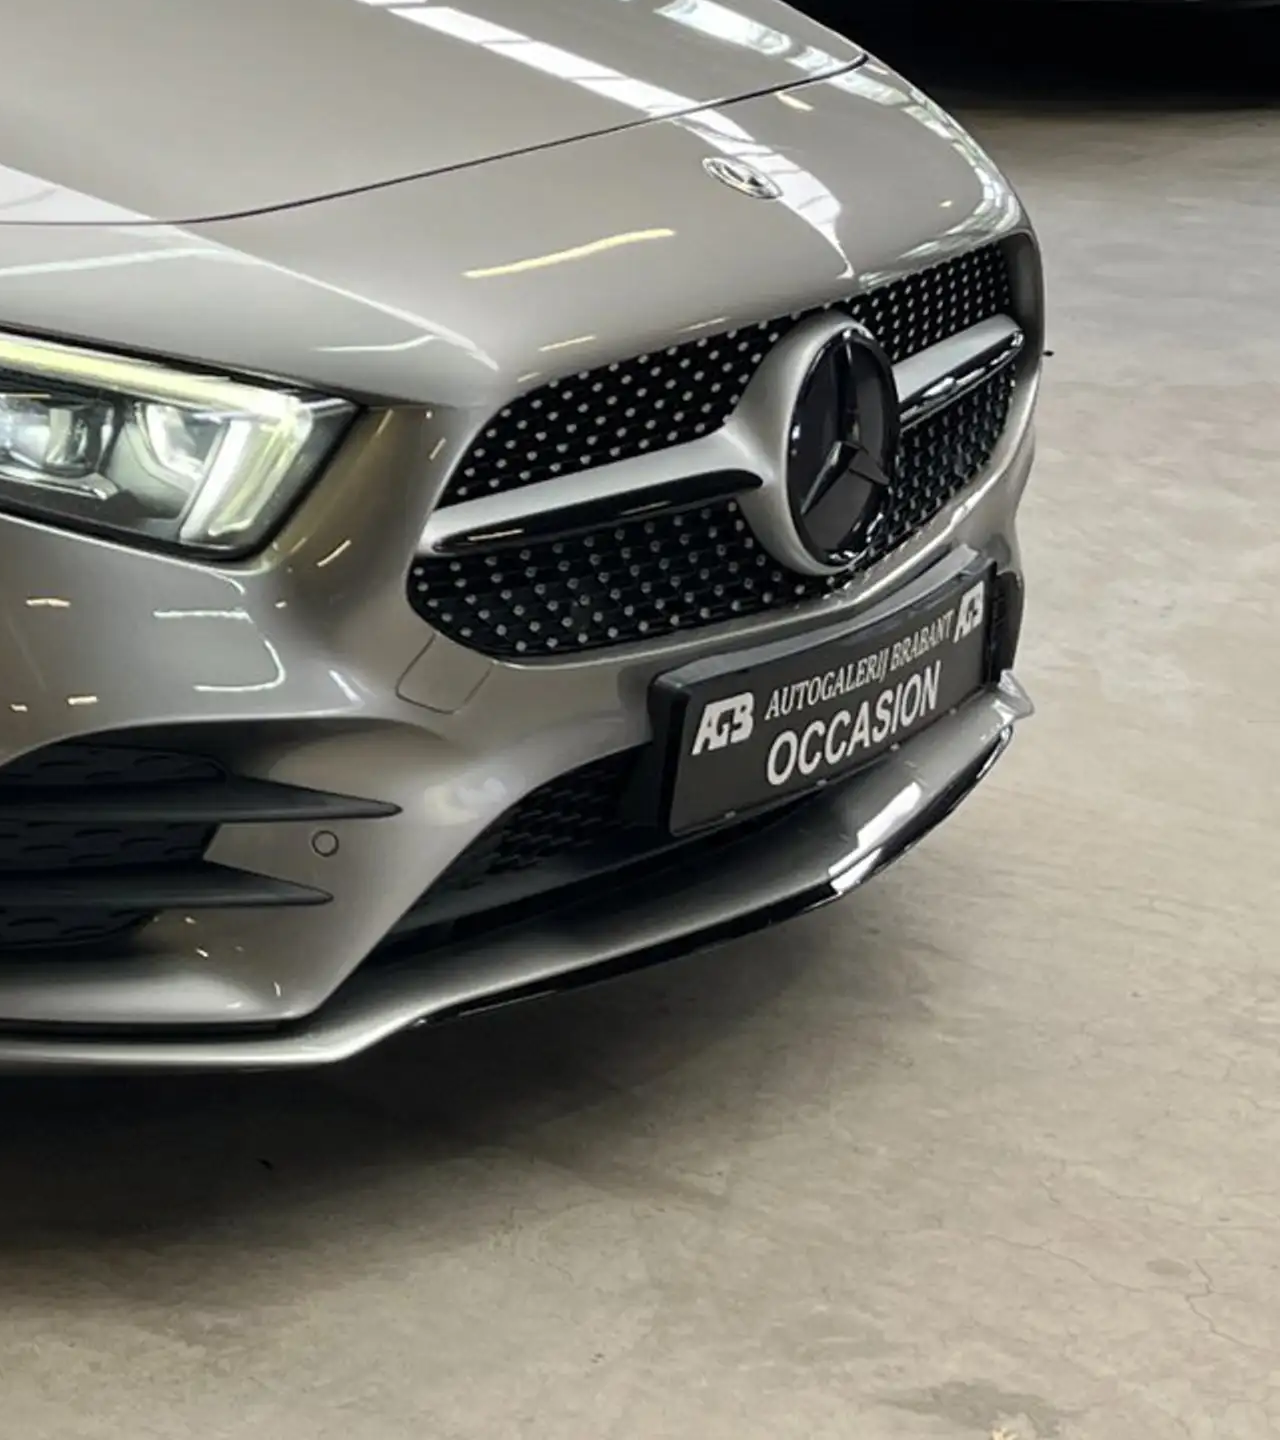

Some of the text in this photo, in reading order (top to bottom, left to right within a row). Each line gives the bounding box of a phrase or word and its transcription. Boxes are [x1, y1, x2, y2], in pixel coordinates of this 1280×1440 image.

[764, 608, 955, 721] AUTOGALERIJ BRABANT
[766, 660, 942, 786] OCCASION
